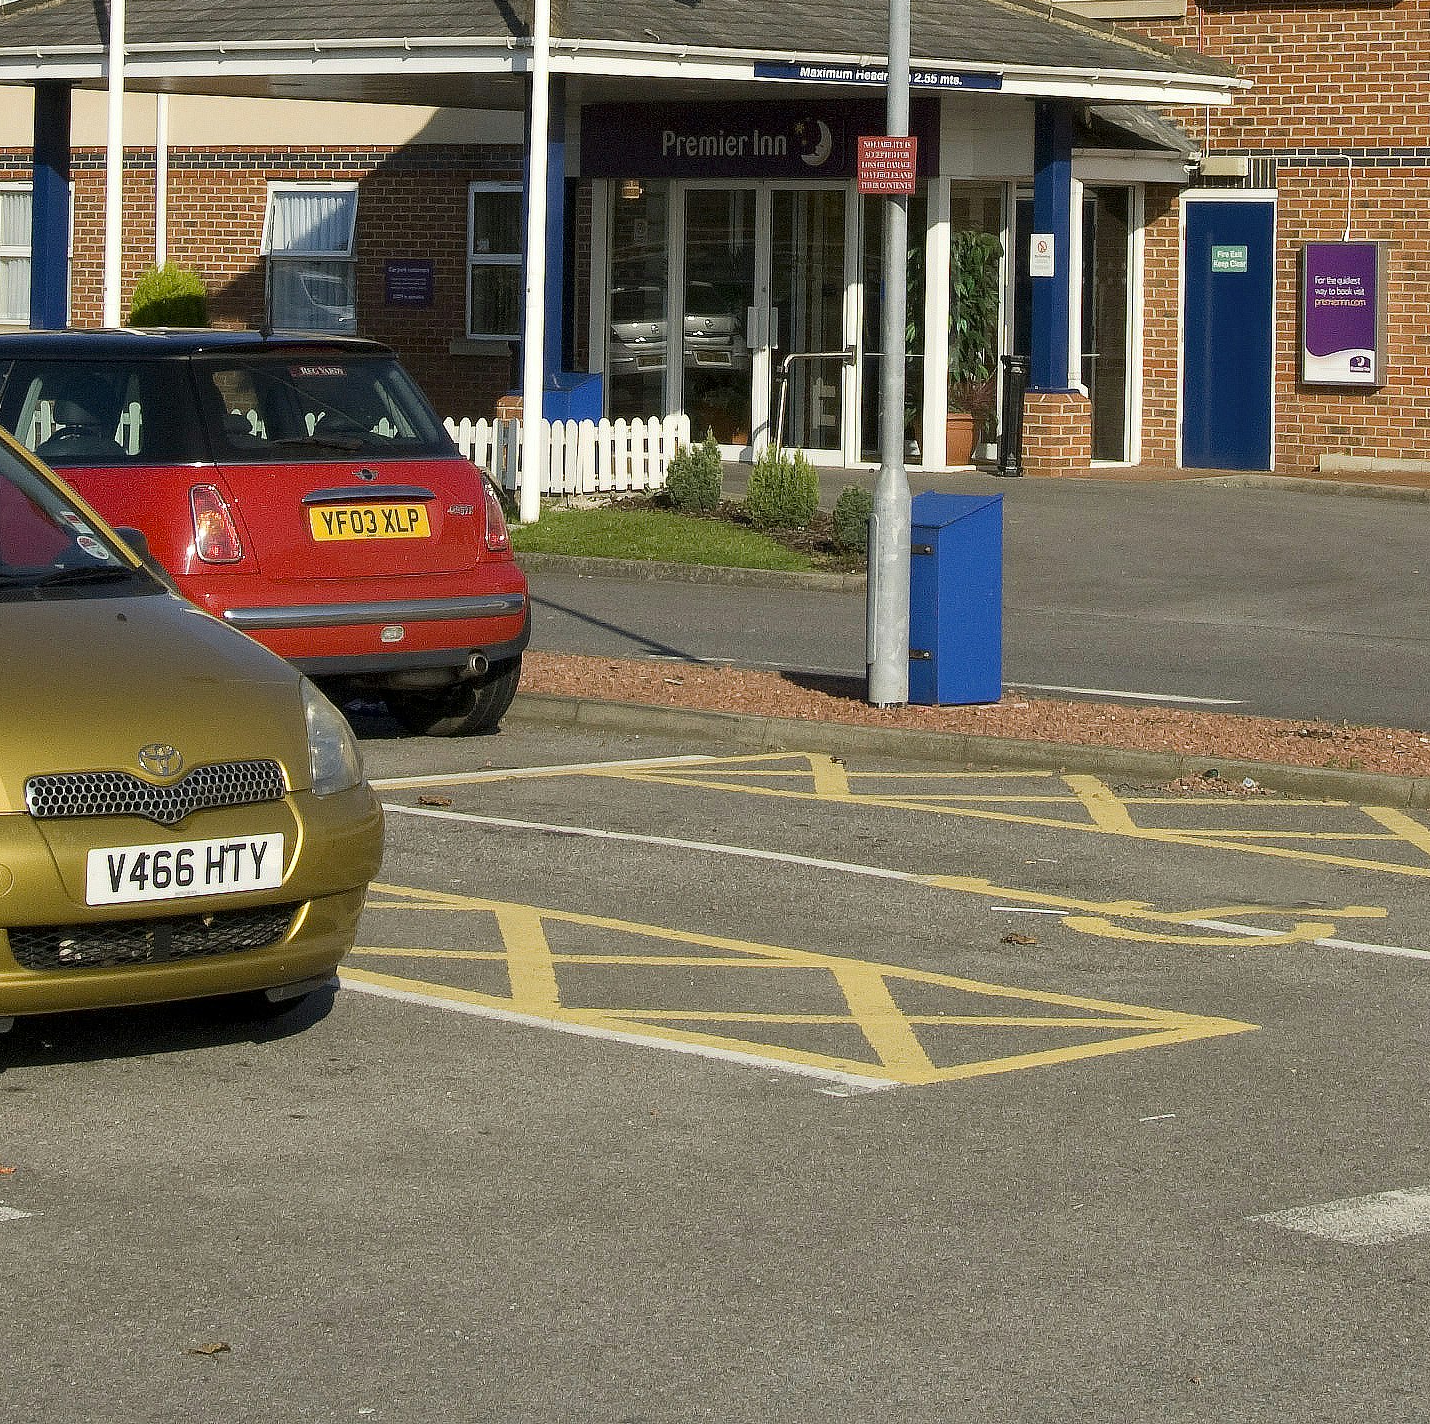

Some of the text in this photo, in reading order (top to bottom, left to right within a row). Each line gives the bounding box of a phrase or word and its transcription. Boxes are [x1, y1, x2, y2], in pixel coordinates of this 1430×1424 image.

[800, 67, 853, 80] Maximum
[662, 129, 787, 157] Premier Inn
[1315, 275, 1325, 284] For
[321, 510, 378, 535] YF03
[381, 508, 419, 533] XLP
[107, 842, 268, 893] V466 HTY
